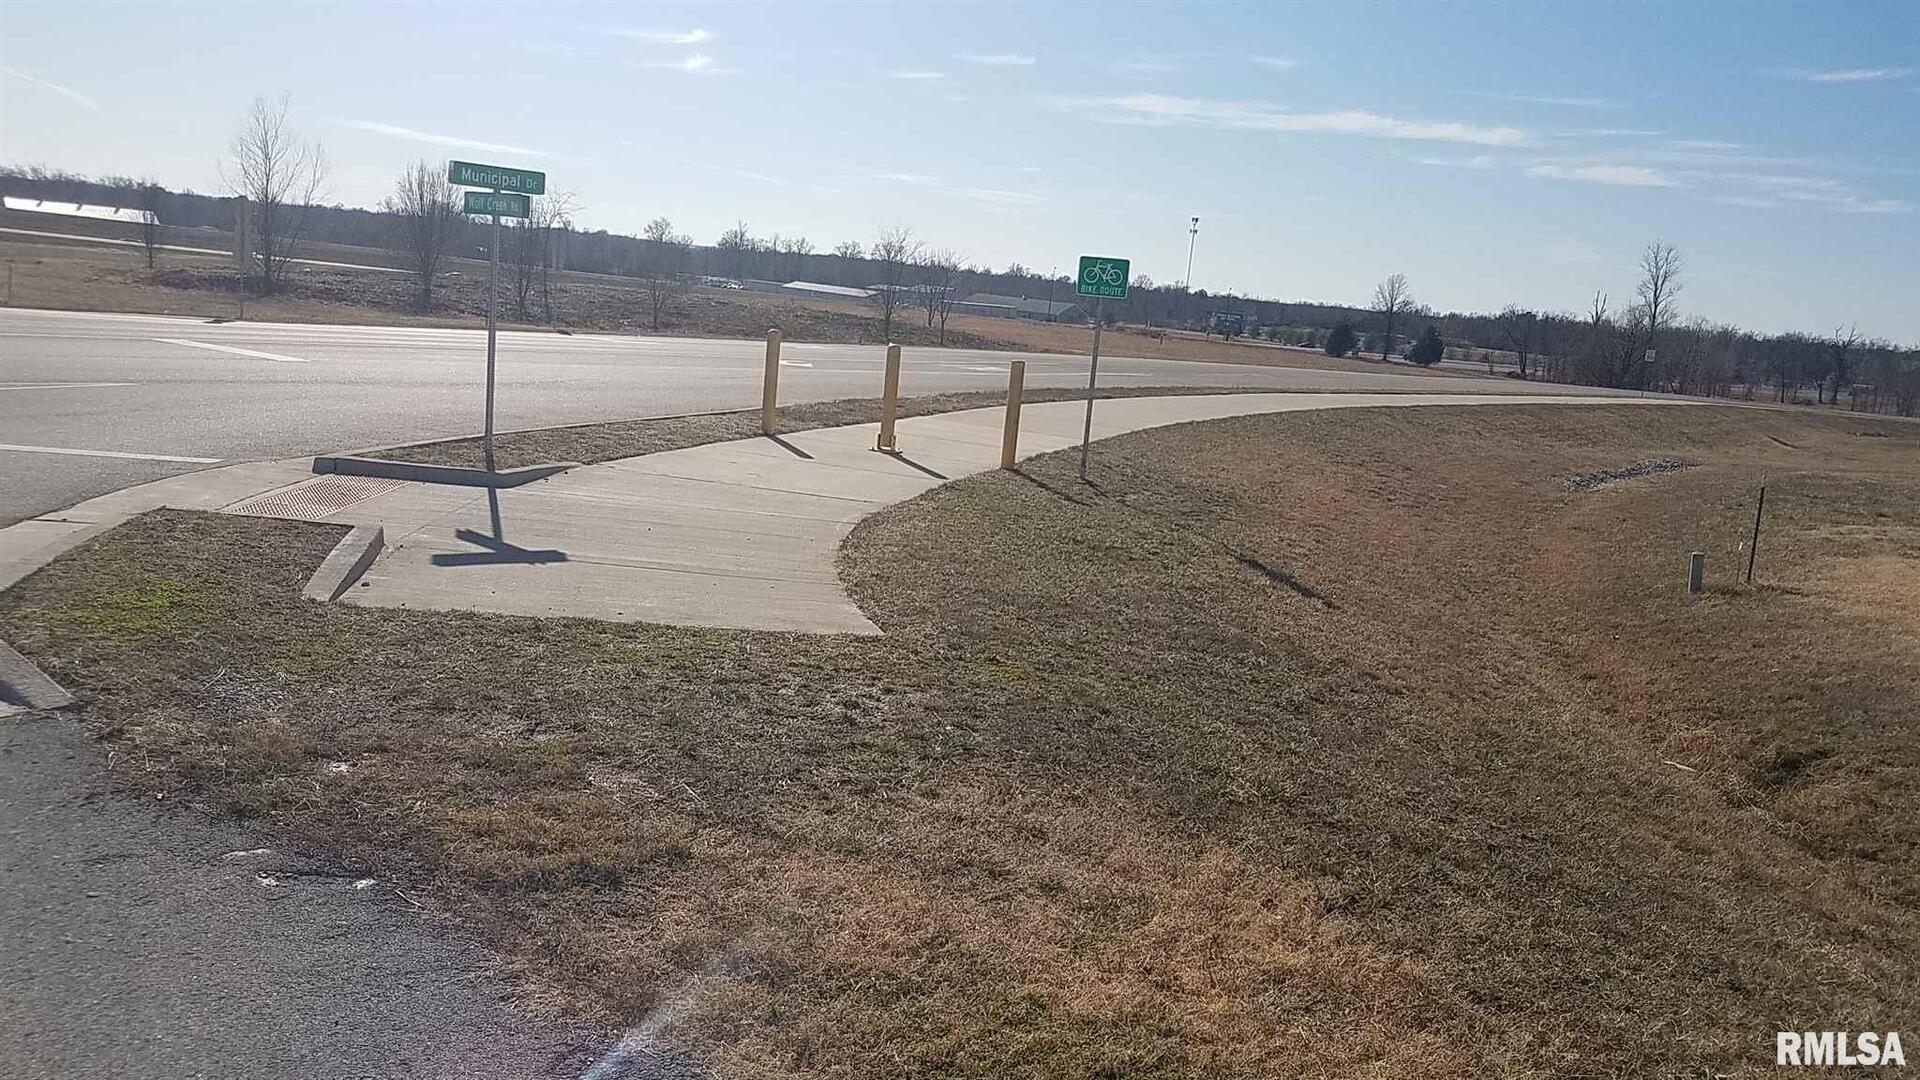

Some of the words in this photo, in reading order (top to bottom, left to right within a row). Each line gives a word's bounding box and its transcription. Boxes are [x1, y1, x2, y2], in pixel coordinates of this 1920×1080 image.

[461, 167, 520, 188] Municipal
[526, 178, 539, 190] Dr
[1080, 284, 1097, 293] BIKE
[1100, 286, 1124, 296] ROUTE
